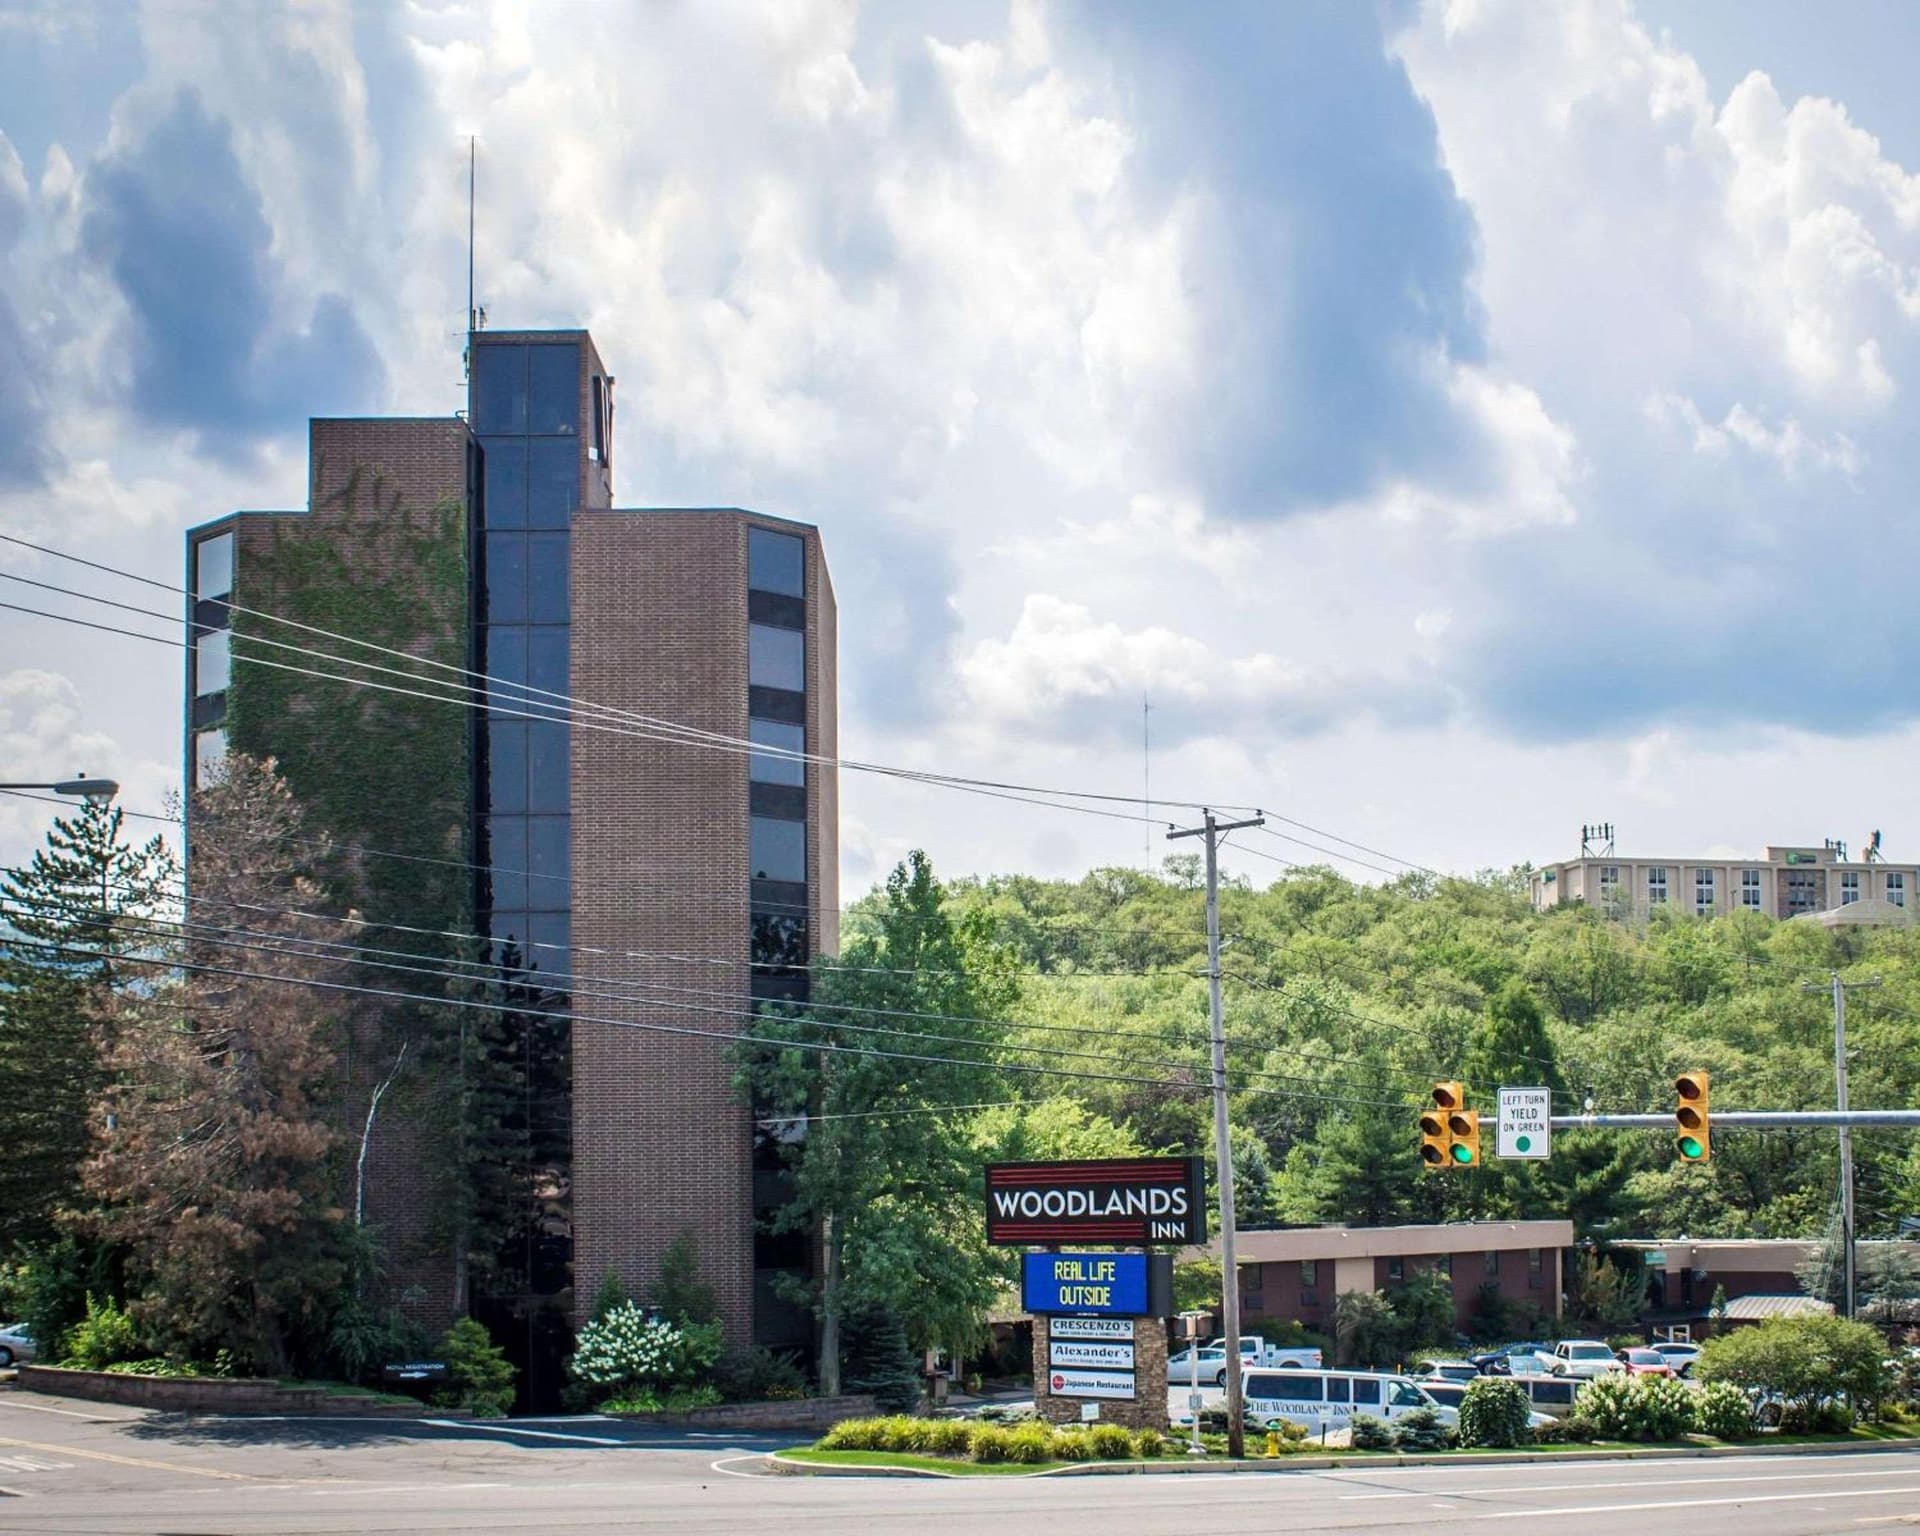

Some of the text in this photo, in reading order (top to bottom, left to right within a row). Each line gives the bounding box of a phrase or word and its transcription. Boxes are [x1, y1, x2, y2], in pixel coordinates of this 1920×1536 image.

[1503, 1095, 1545, 1105] LEFT TURN
[1510, 1108, 1538, 1119] YIELD
[1503, 1122, 1545, 1132] ON GREEN
[993, 1187, 1188, 1218] WOODLANDS
[1151, 1221, 1186, 1239] INN
[1054, 1261, 1116, 1281] REAL LIFE
[1059, 1286, 1111, 1306] OUTSIDE
[1053, 1320, 1131, 1331] CRESCENZO'S
[1055, 1345, 1131, 1358] Alexander's
[1065, 1379, 1133, 1390] Japanese Restaurant
[1250, 1400, 1270, 1413] THE
[1333, 1404, 1352, 1416] INN
